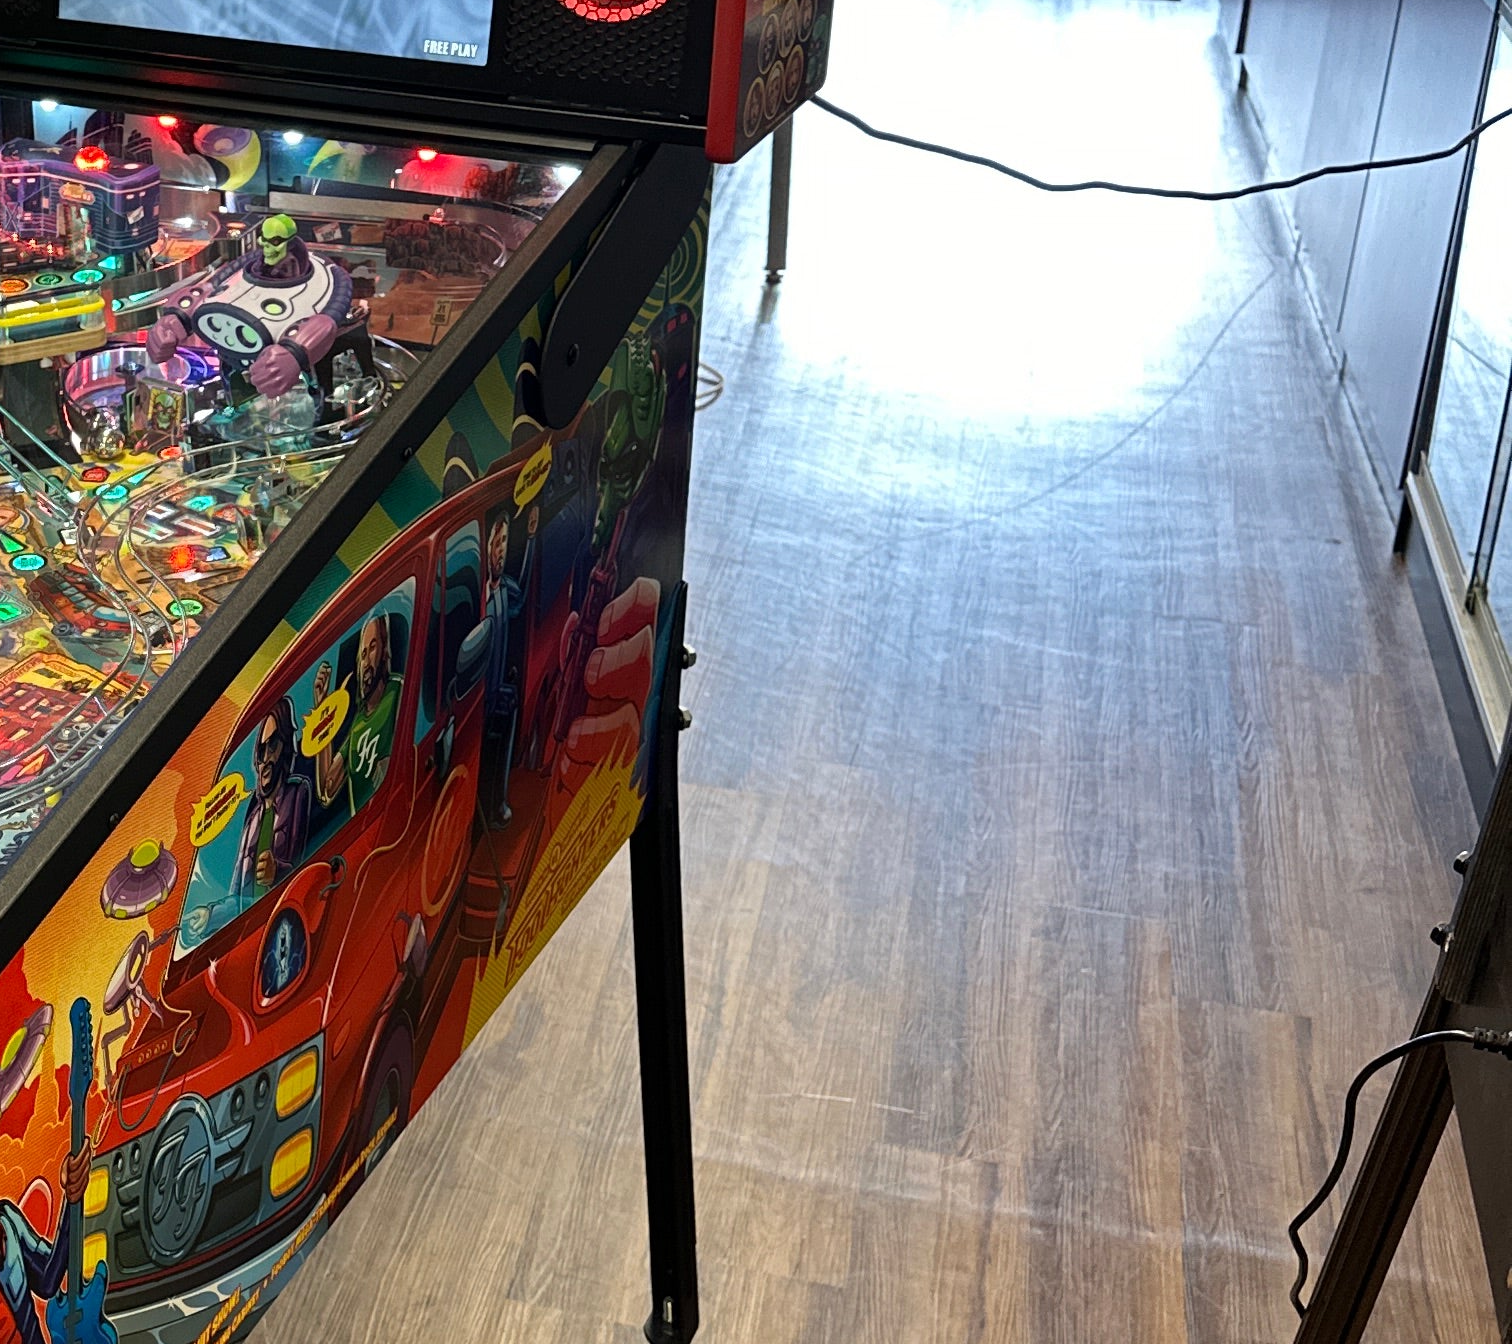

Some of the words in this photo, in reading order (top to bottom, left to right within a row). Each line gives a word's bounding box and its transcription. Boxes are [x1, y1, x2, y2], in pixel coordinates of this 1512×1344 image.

[423, 39, 449, 56] FREE
[450, 42, 479, 58] PLAY
[211, 1285, 242, 1335] SHOW!
[231, 1286, 261, 1333] CABINET
